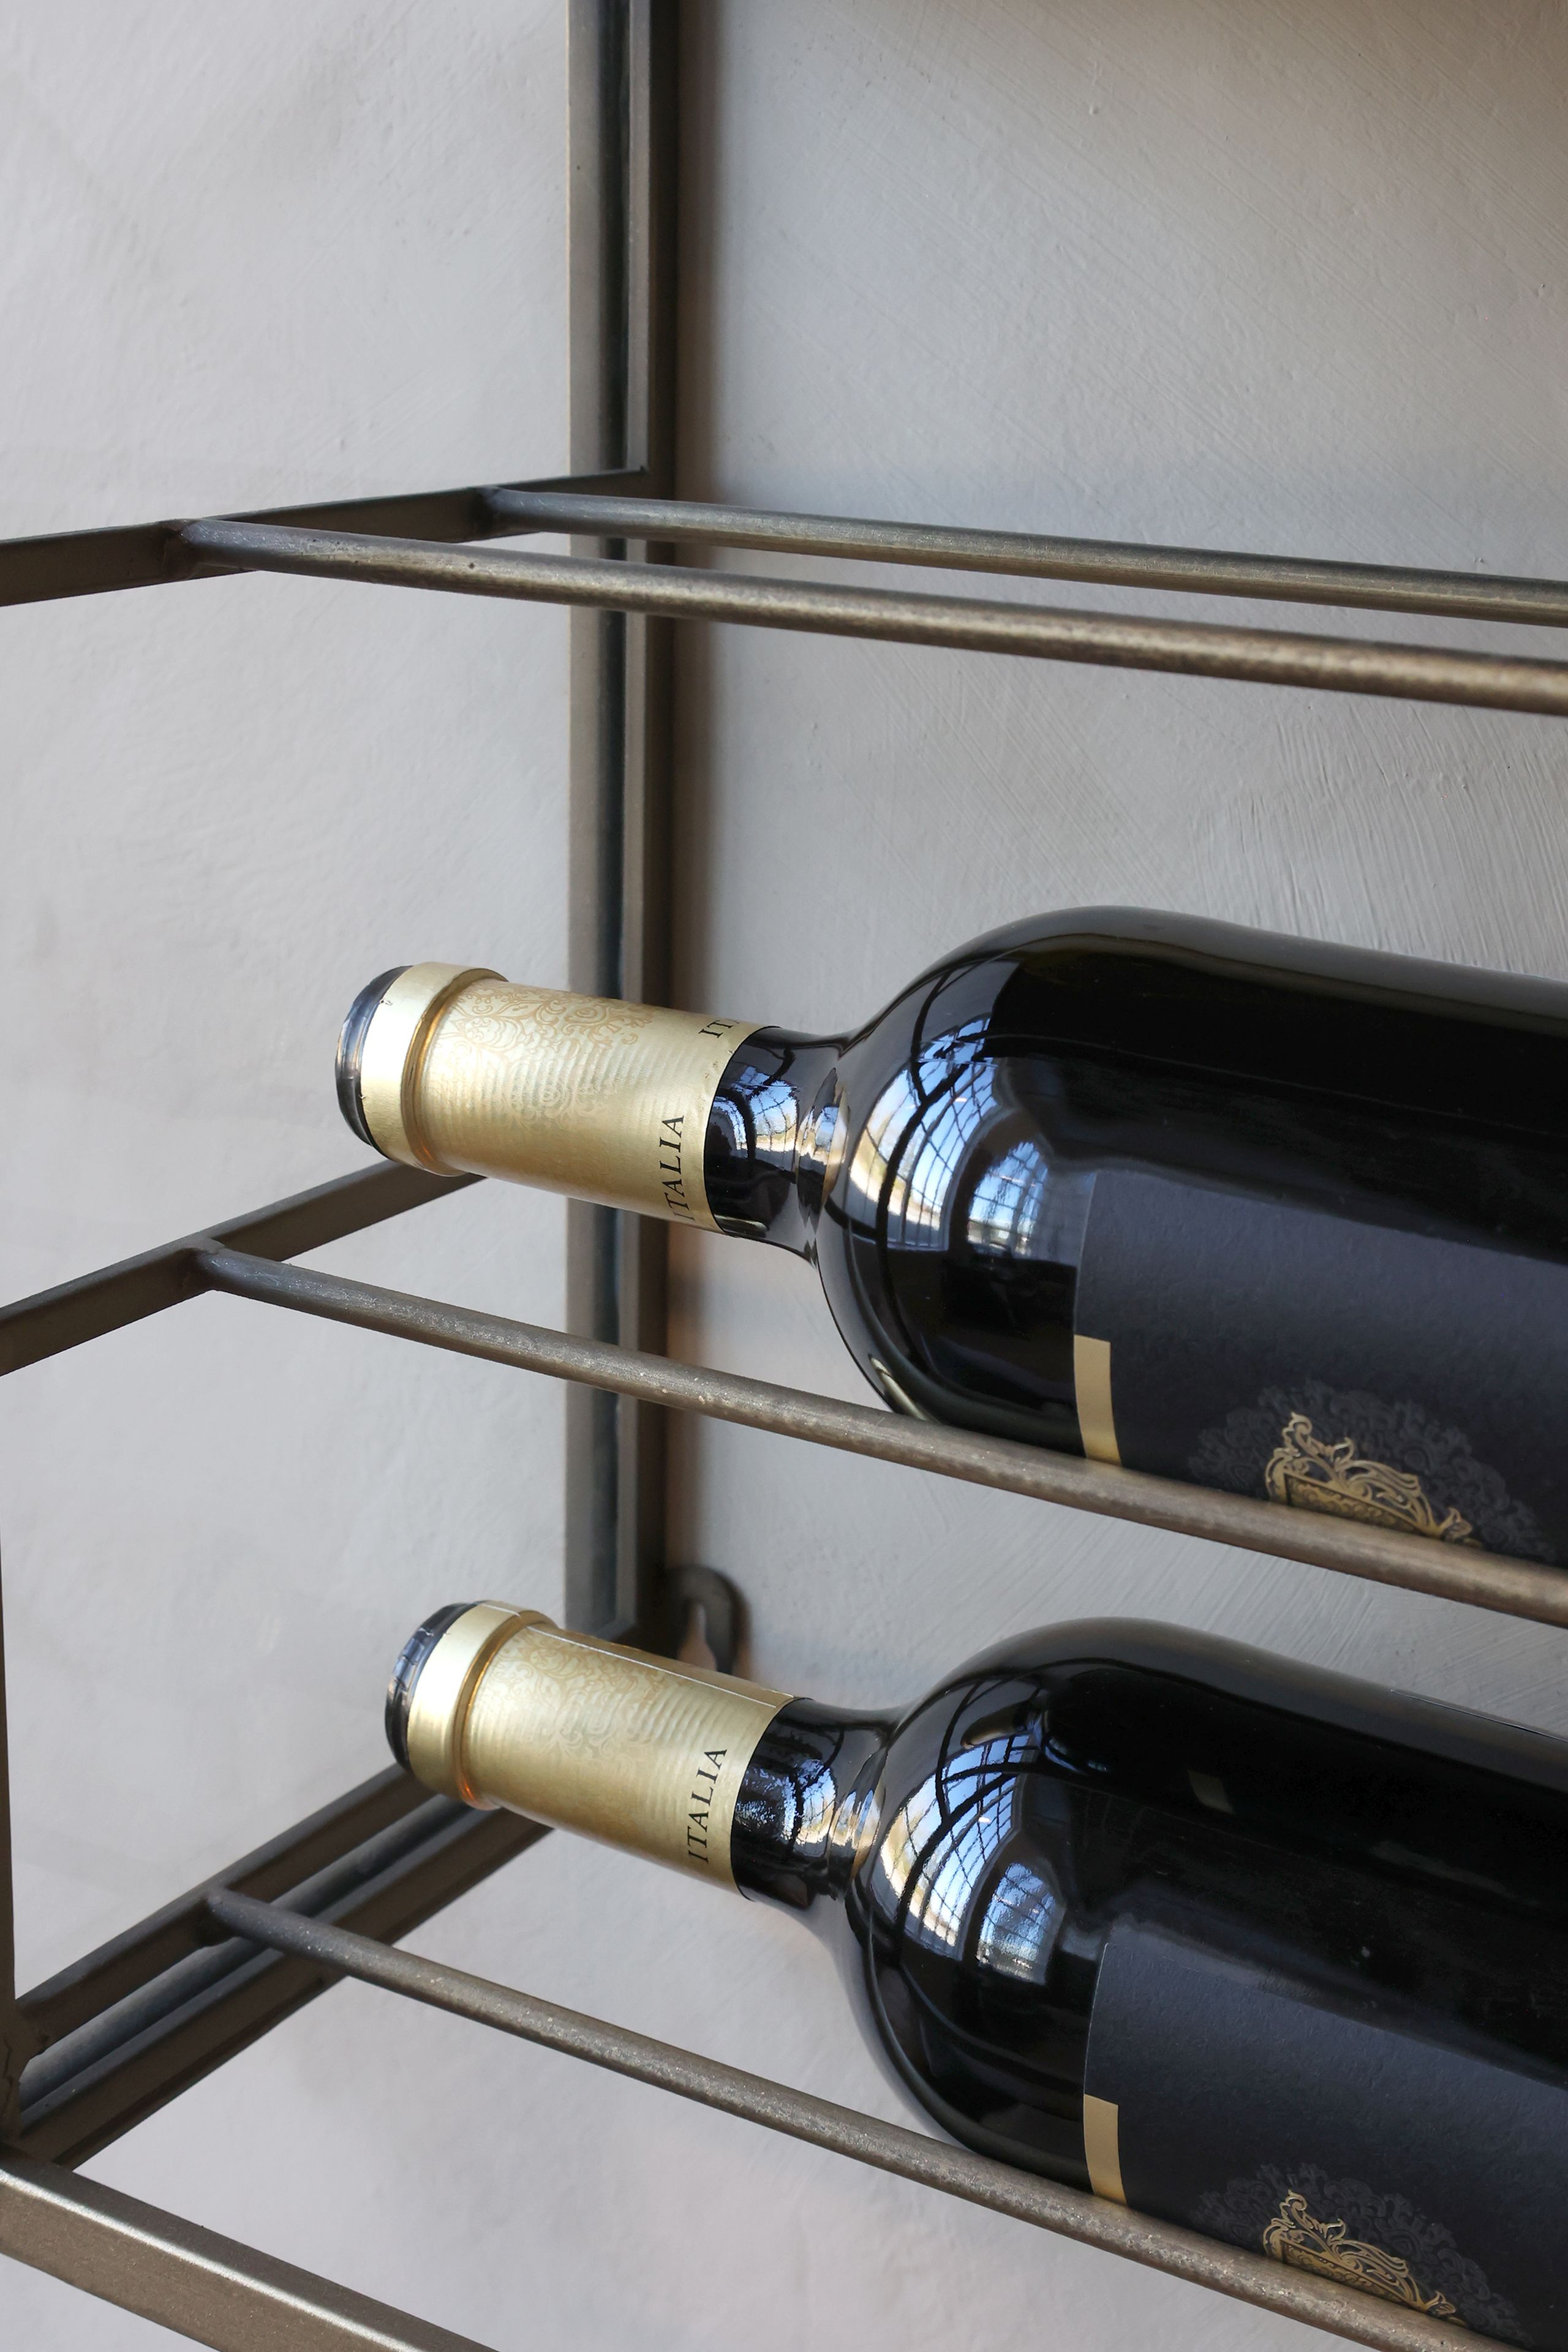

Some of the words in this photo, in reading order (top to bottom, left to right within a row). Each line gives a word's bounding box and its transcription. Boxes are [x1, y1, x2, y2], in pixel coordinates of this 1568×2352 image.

[698, 1019, 740, 1039] IT
[659, 1115, 696, 1221] ITALIA
[687, 1749, 728, 1863] ITALIA
